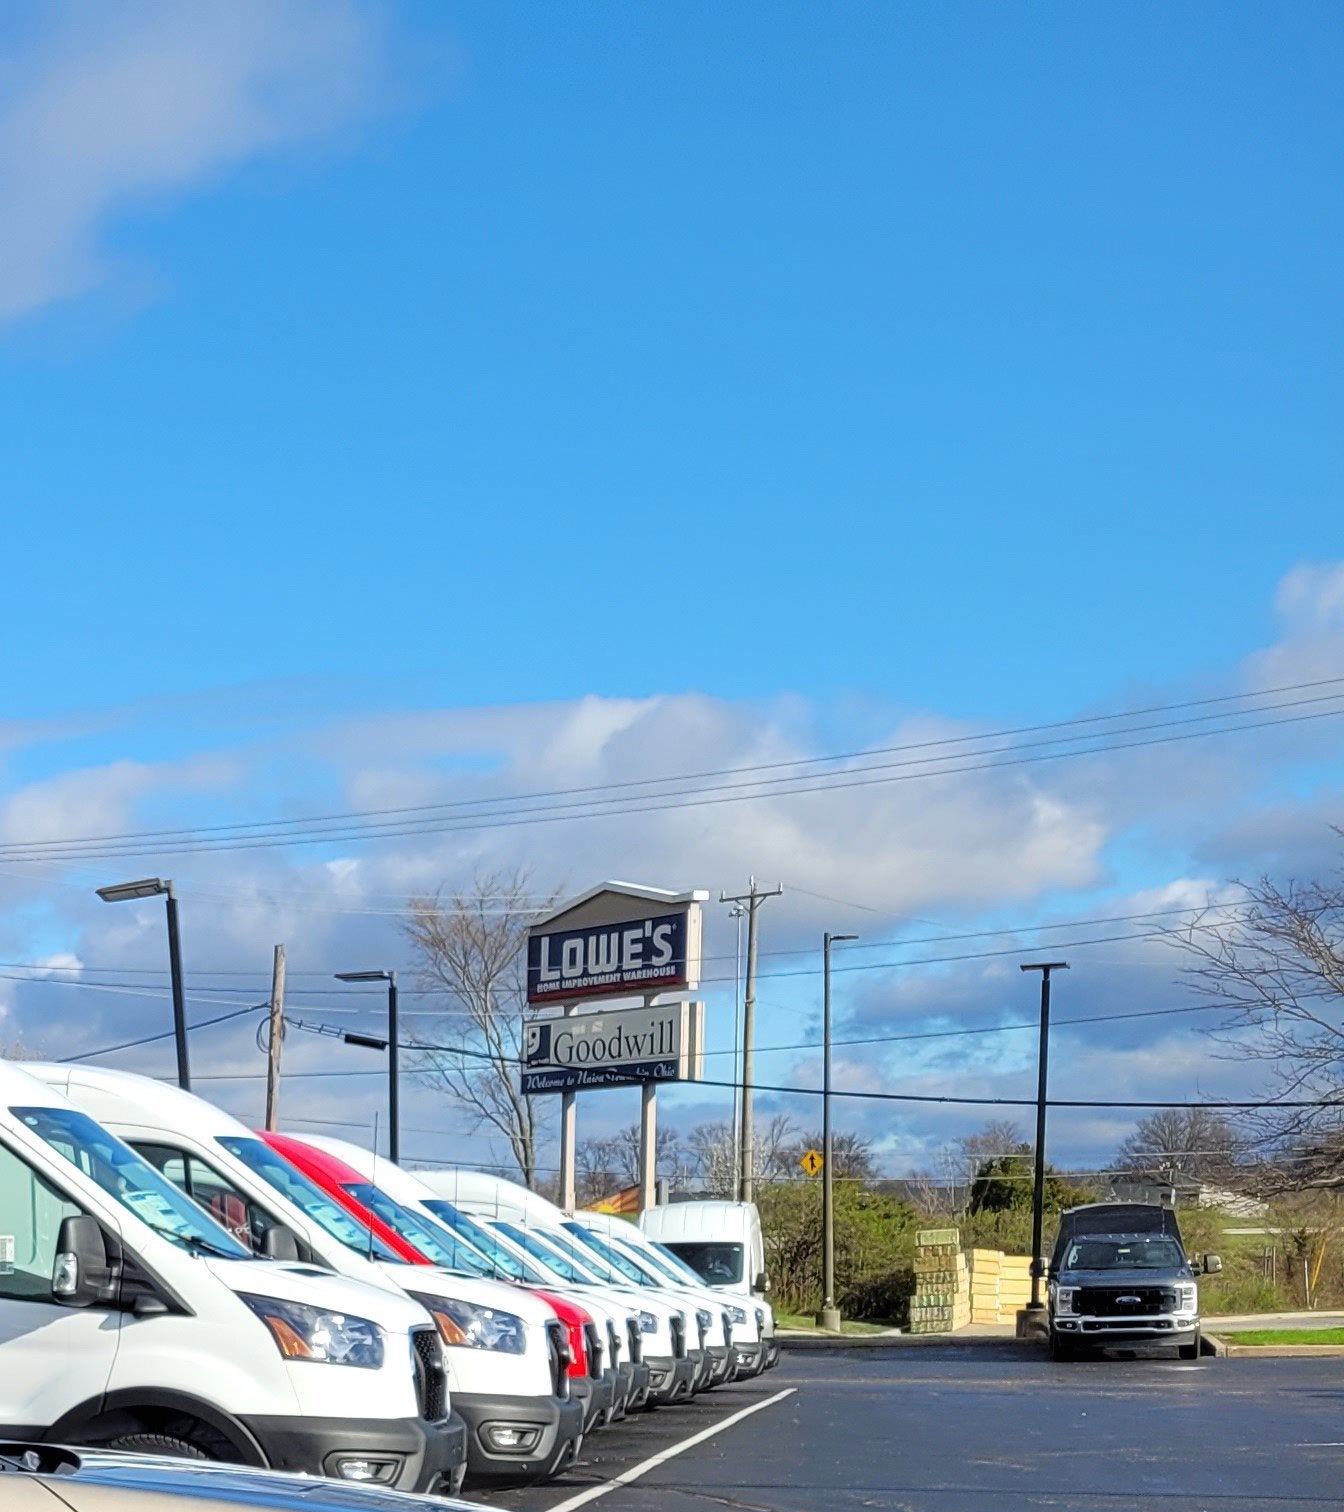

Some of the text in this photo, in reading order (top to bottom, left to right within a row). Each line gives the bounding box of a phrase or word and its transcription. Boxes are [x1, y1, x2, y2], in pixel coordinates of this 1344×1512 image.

[540, 920, 673, 981] LOWE'S
[536, 965, 676, 993] HOME IMPROVEMENT WAREHOUSE
[554, 1018, 675, 1064] Goodwill
[526, 1075, 564, 1090] Welcome
[566, 1075, 575, 1086] to
[577, 1070, 605, 1085] Union
